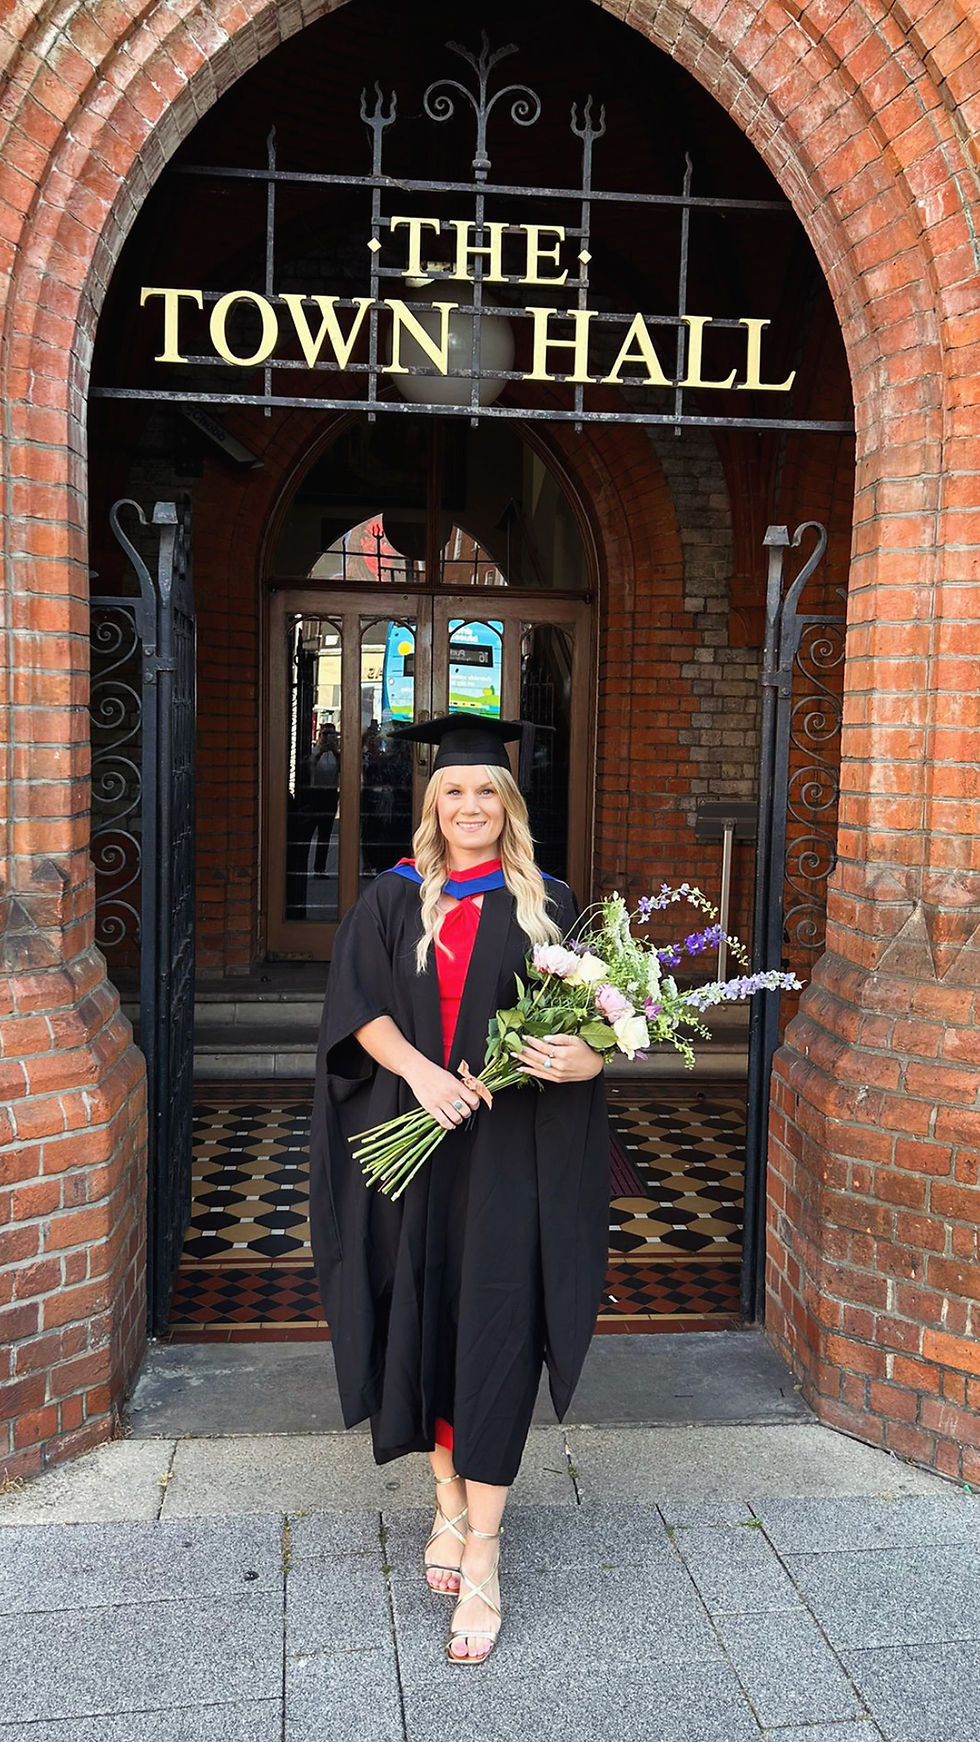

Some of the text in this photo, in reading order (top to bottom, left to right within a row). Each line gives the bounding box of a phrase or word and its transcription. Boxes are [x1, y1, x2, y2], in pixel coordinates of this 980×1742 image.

[390, 216, 568, 285] THE
[139, 286, 796, 391] TOWN HALL
